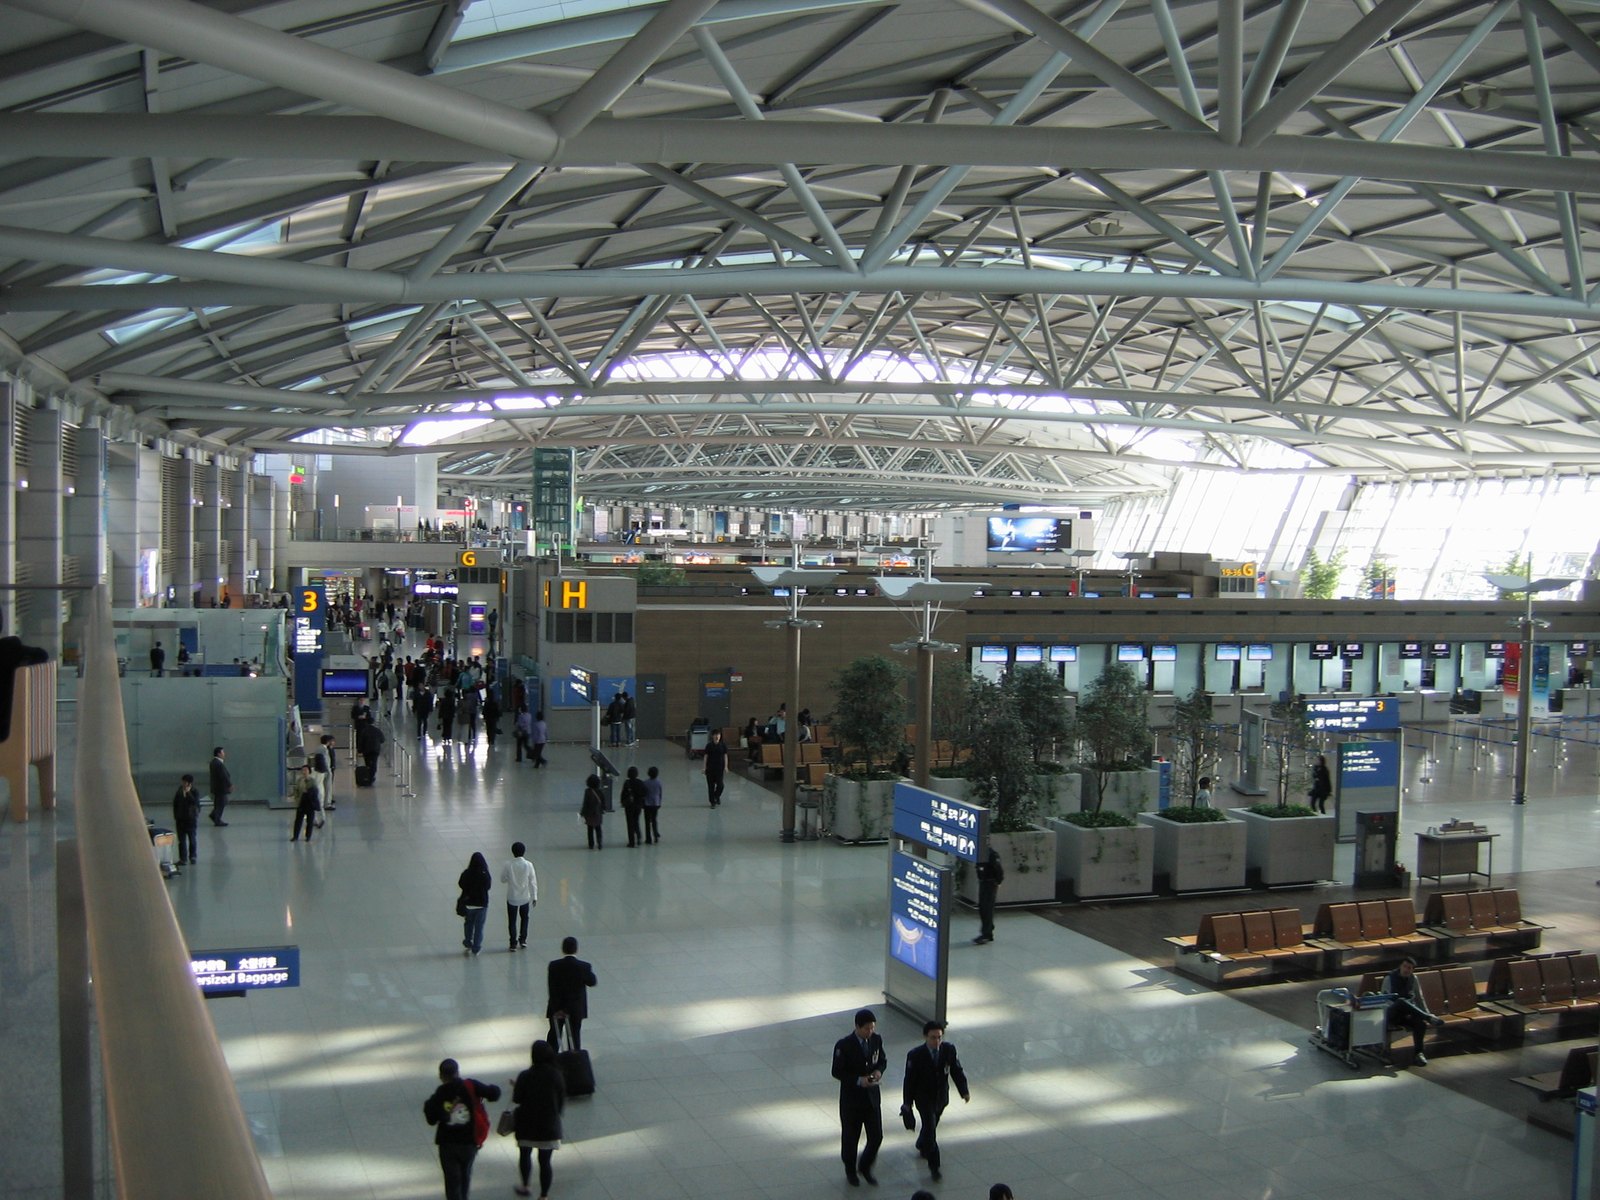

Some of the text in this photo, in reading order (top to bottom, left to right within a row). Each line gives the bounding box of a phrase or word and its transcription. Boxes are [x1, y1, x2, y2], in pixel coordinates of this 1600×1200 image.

[461, 551, 476, 566] G
[1242, 563, 1254, 576] G
[302, 590, 319, 612] 3
[562, 581, 587, 609] H
[1376, 701, 1385, 712] 3
[196, 972, 288, 986] ersized Baggage
